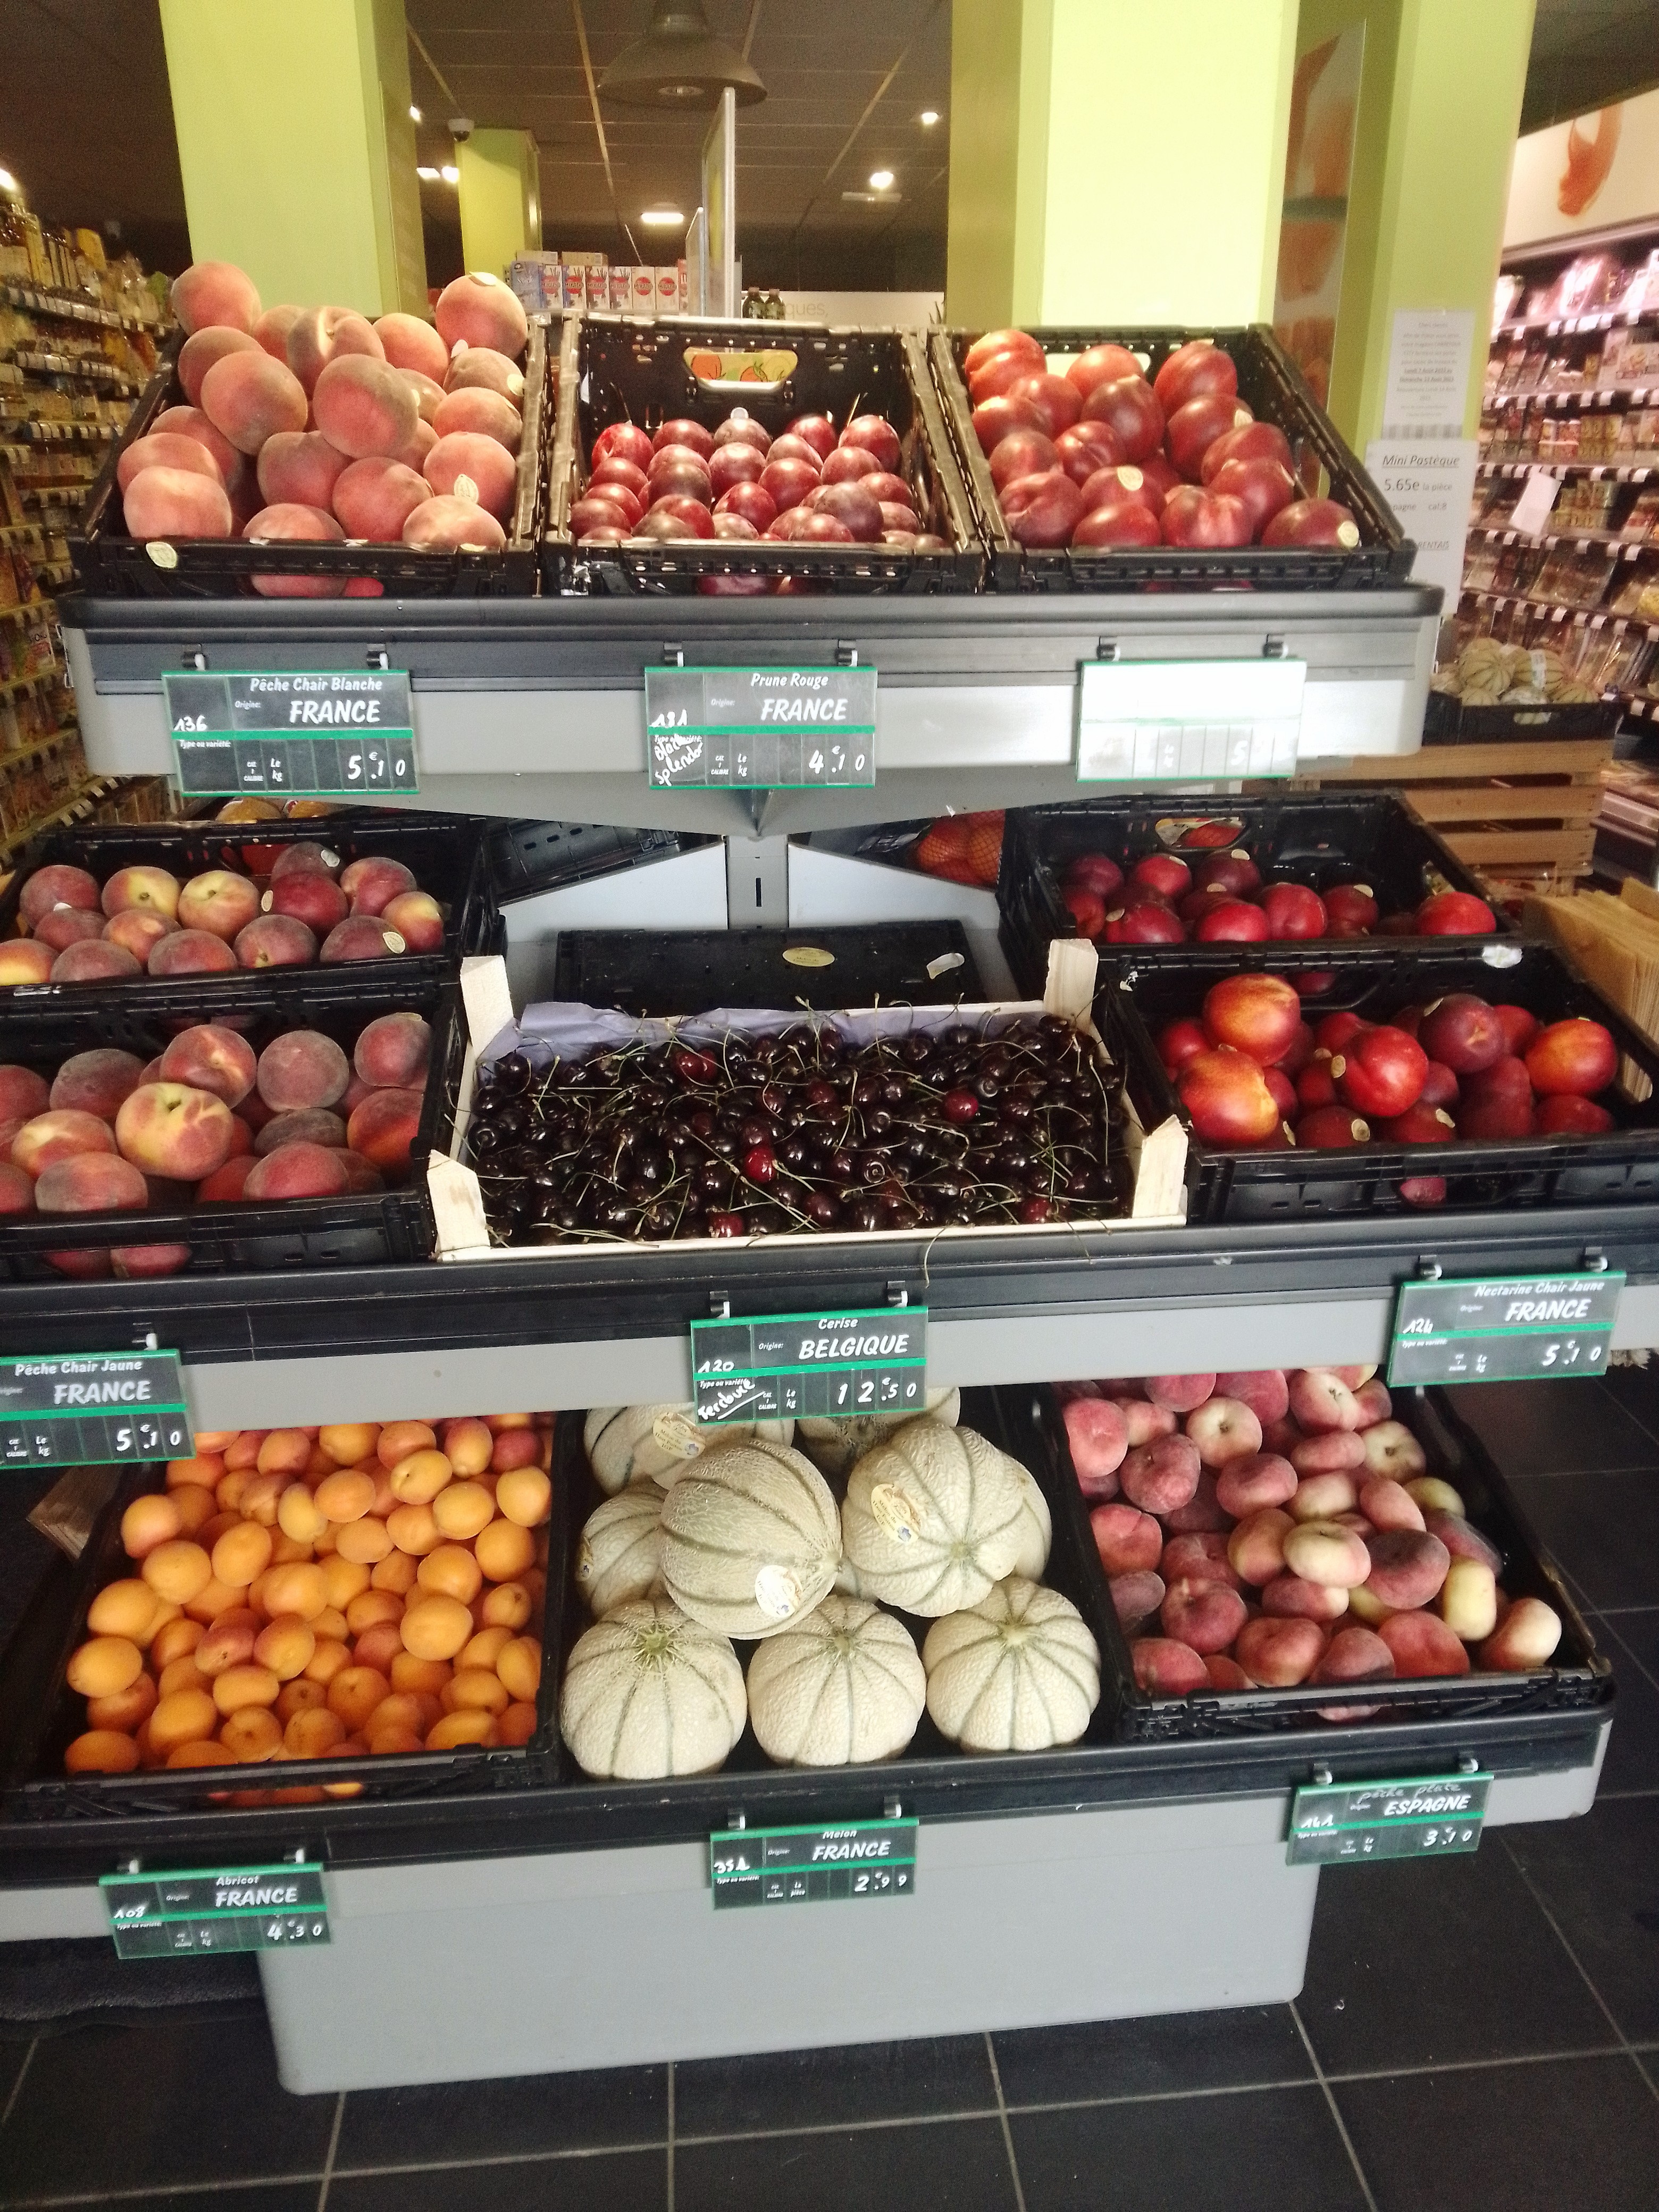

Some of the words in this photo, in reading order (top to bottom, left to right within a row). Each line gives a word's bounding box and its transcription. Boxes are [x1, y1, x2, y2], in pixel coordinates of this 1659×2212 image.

[1383, 455, 1408, 465] Mini
[1410, 455, 1460, 467] Pastèque
[1384, 479, 1419, 491] 5.65e
[1432, 483, 1452, 492] pièce
[250, 678, 289, 692] Pêche
[293, 677, 328, 691] Chair
[331, 676, 382, 691] Blanche
[751, 672, 787, 687] Prune
[790, 673, 828, 690] Rouge
[290, 700, 380, 724] FRANCE
[760, 698, 848, 721] FRANCE
[271, 758, 281, 767] Le
[738, 753, 747, 763] Le
[272, 770, 282, 782] kg
[738, 765, 747, 777] kg
[1474, 1284, 1532, 1297] Nectarine
[1535, 1282, 1566, 1294] Chair
[1570, 1281, 1604, 1293] Jaune
[1505, 1298, 1591, 1322] FRANCE
[818, 1318, 858, 1330] Cerise
[759, 1342, 784, 1351] Origine:
[799, 1334, 910, 1360] BELGIQUE
[15, 1363, 57, 1377] Pêche
[60, 1360, 98, 1374] Chair
[101, 1359, 143, 1372] Jaune
[54, 1380, 151, 1405] FRANCE
[786, 1389, 796, 1397] Le
[786, 1398, 796, 1409] kg
[36, 1436, 47, 1444] Le
[38, 1446, 49, 1456] kg
[1384, 1795, 1471, 1816] ESPAGNE
[823, 1830, 857, 1839] Melon
[812, 1841, 891, 1861] FRANCE
[215, 1875, 260, 1886] Abricot
[215, 1888, 298, 1908] FRANCE
